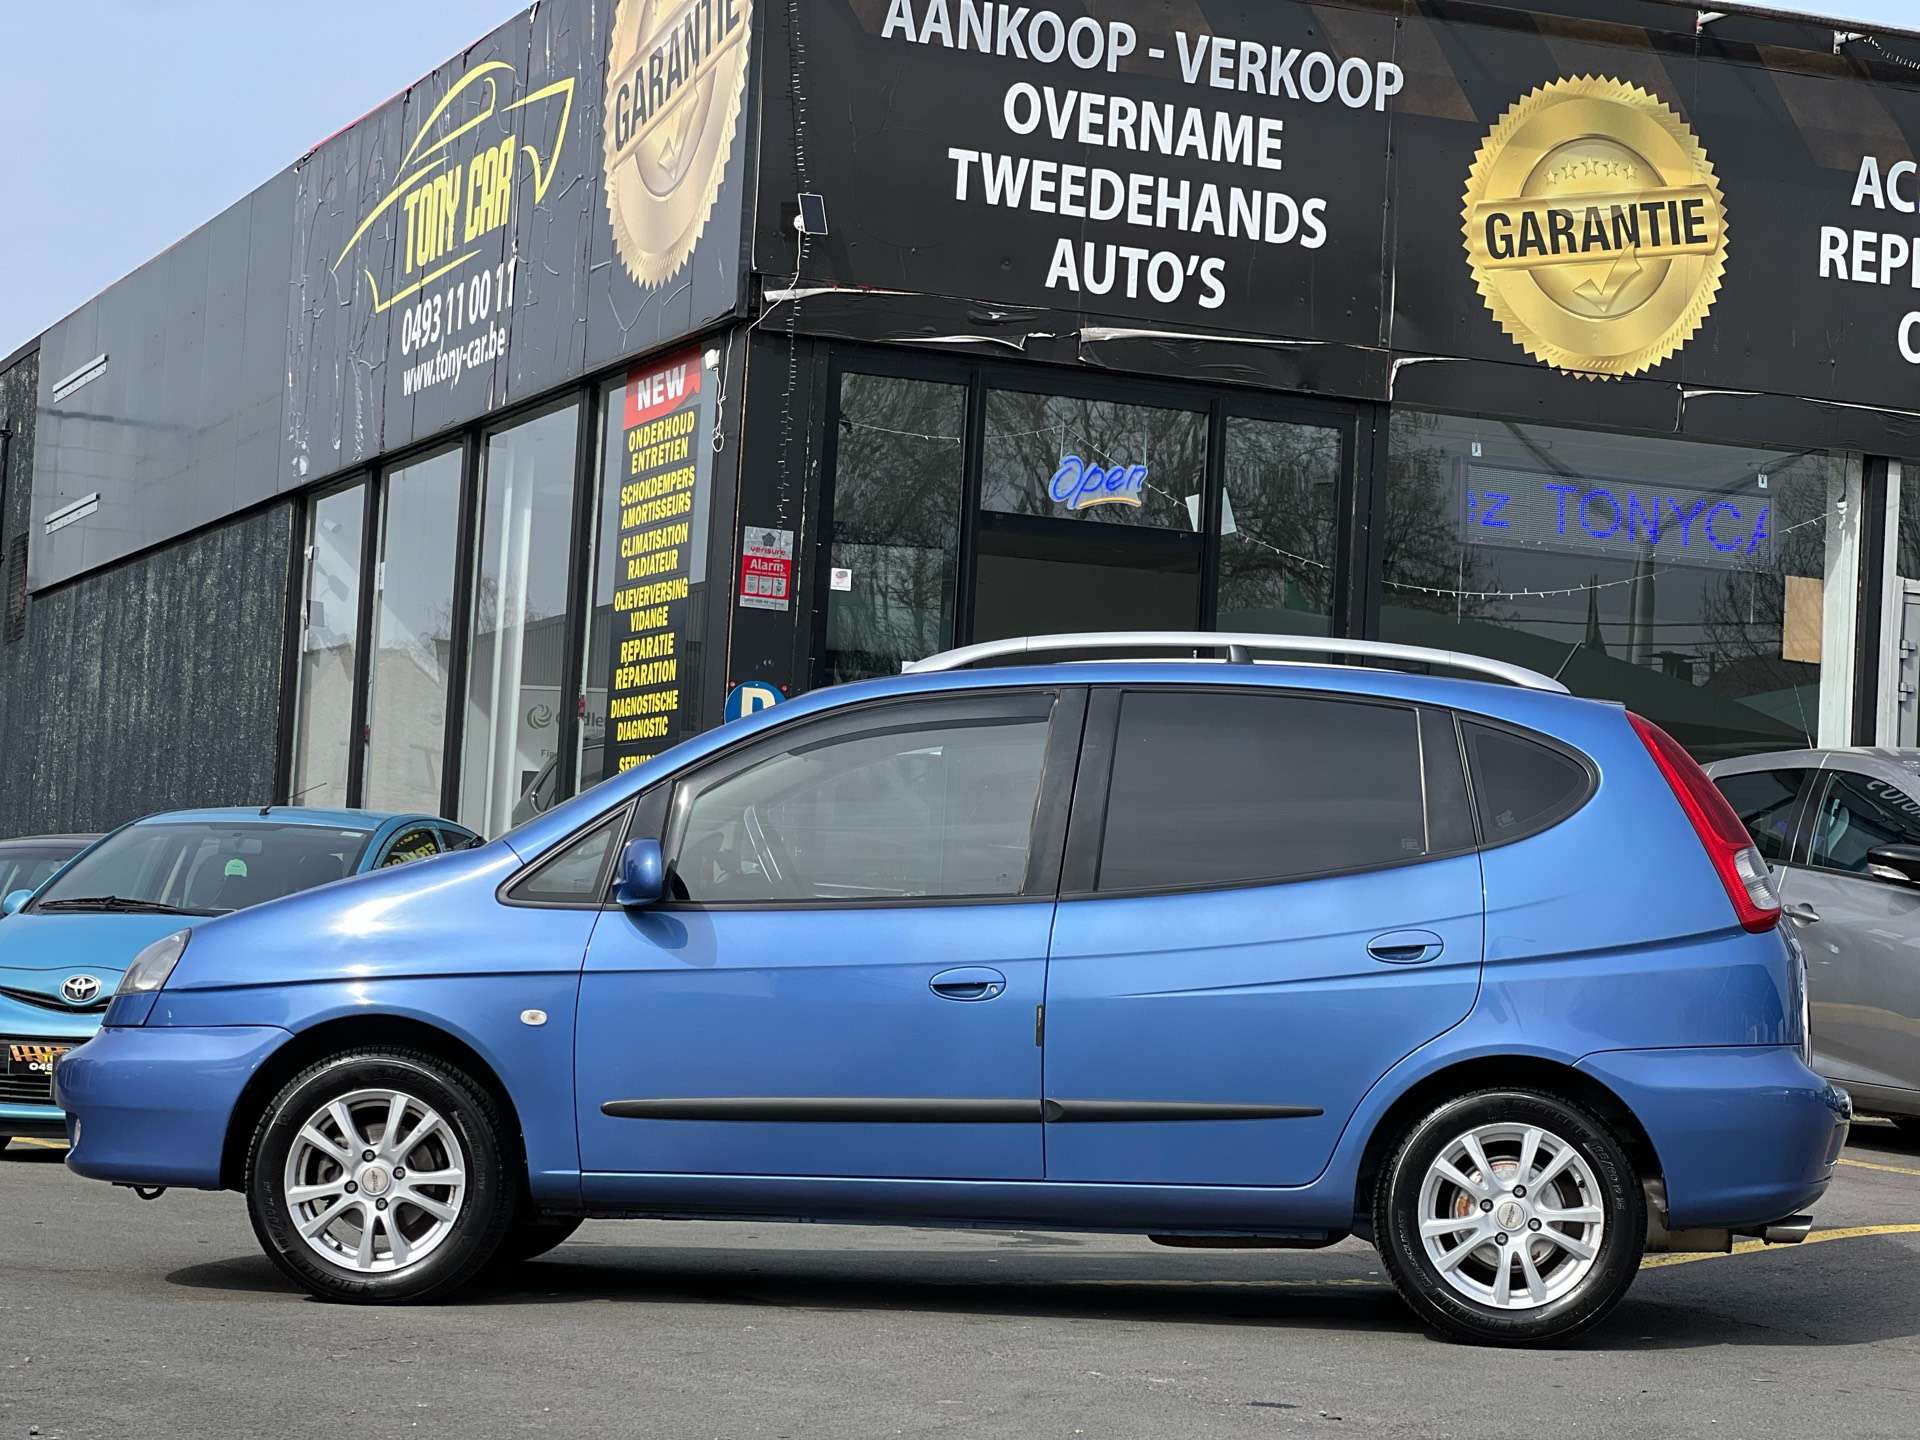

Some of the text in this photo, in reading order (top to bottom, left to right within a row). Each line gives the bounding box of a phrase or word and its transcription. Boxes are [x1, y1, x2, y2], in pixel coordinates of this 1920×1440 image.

[881, 0, 1136, 72] AANKOOP
[1175, 31, 1403, 111] VERKOOP
[1003, 82, 1283, 170] OVERNAME
[404, 134, 516, 274] TONY CAR
[948, 147, 1327, 249] TWEEDEHANDS
[1851, 155, 1920, 213] AC
[1485, 198, 1708, 260] GARANTIE
[1045, 238, 1226, 309] AUTO'S
[402, 256, 517, 356] 0493 11 00 11
[403, 320, 506, 397] www.tony-car.be
[637, 364, 687, 412] NEW
[628, 411, 695, 452] ONDERHOUD
[631, 436, 689, 475] ENTRETIEN
[621, 465, 695, 507] SCHOKDEMPERS
[1048, 454, 1148, 510] Open
[621, 490, 692, 530] AMORTISSEURS
[621, 521, 689, 558] CLIMATISATION
[627, 548, 679, 580] RADIATEUR
[750, 558, 785, 572] Alarm
[614, 577, 689, 612] OLIEVERVERSING
[630, 605, 669, 632] VIDANGE
[620, 632, 675, 663] REPARATIE
[615, 658, 677, 690] RÉPARATION
[610, 689, 679, 719] DIAGNOSTISCHE
[617, 715, 669, 742] DIAGNOSTIC
